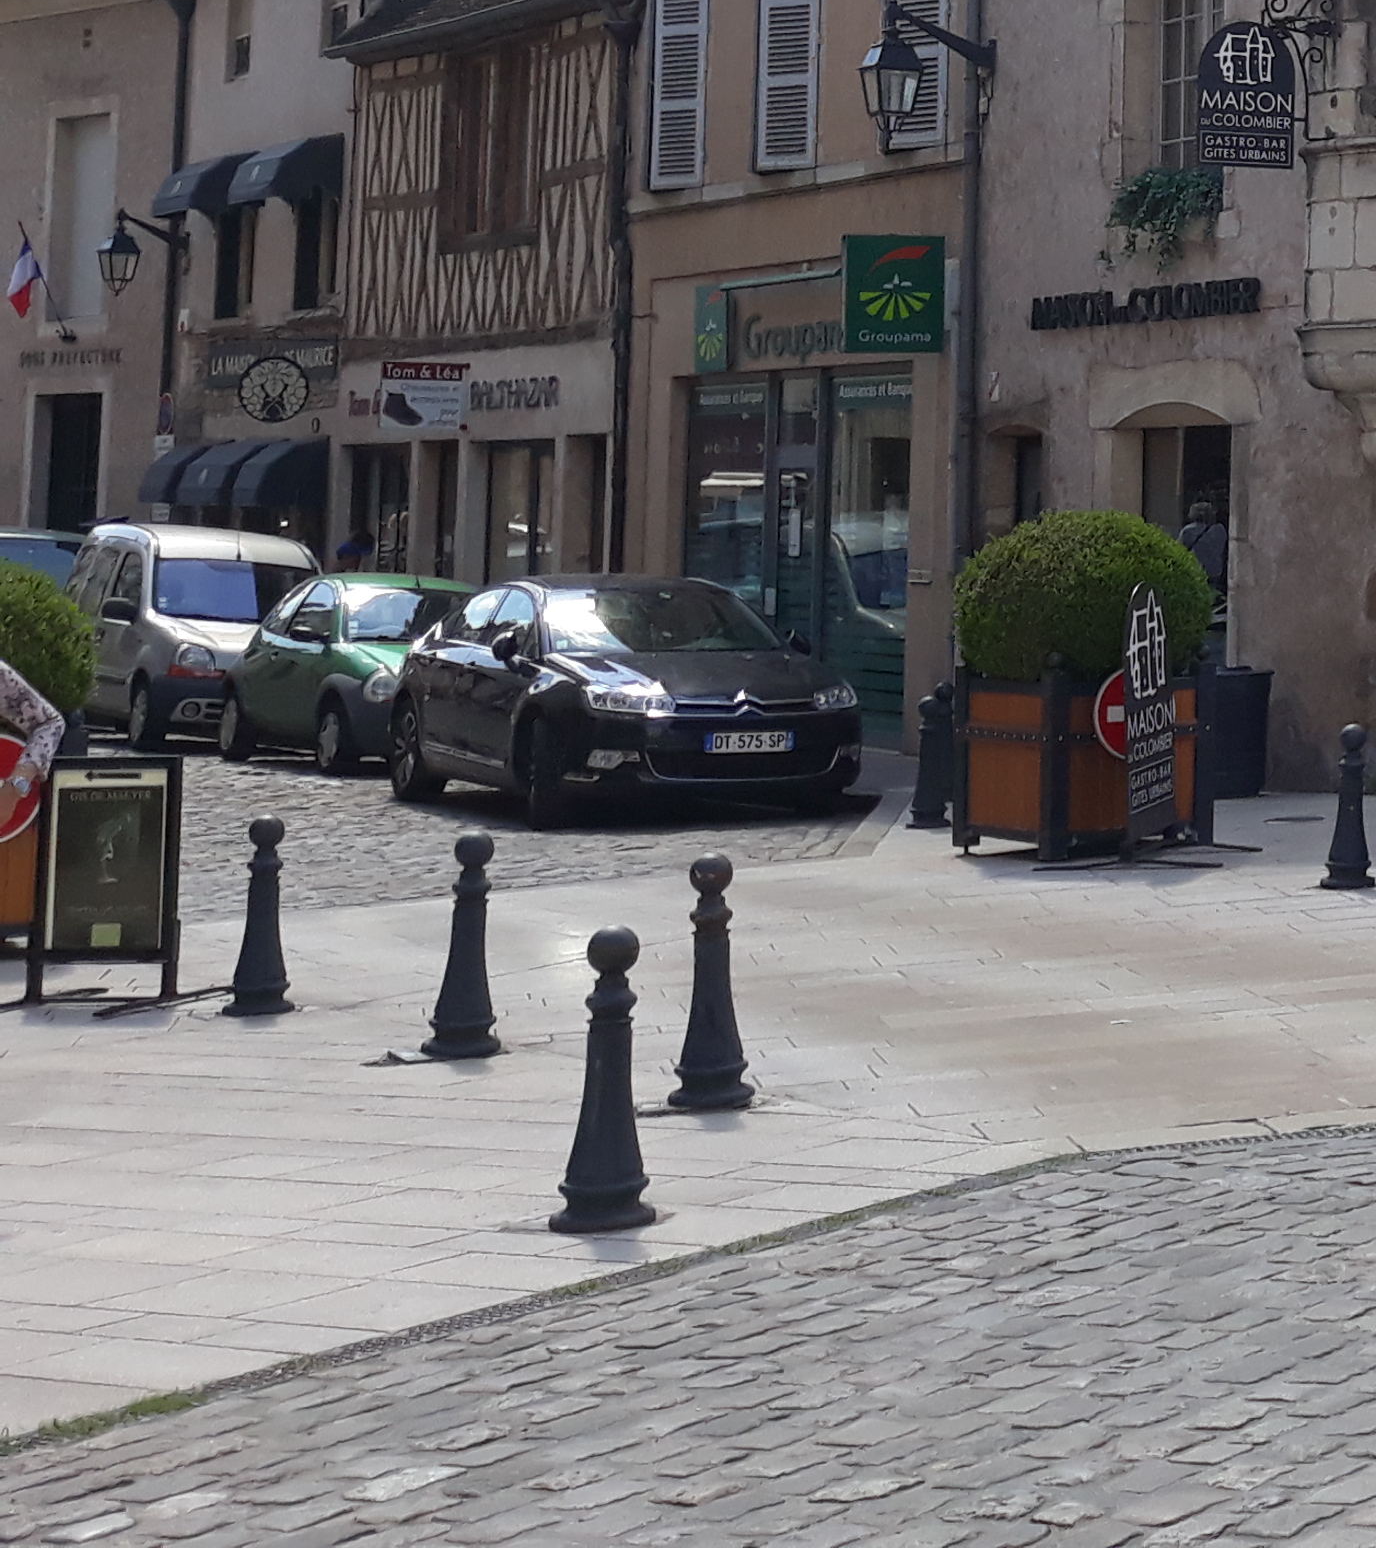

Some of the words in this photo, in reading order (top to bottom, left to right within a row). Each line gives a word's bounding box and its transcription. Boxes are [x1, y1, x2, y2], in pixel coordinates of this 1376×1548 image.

[1201, 90, 1292, 113] MAISON
[1212, 113, 1291, 129] COLOMBIER
[1204, 148, 1236, 159] GITES
[1239, 150, 1286, 161] URBAINS
[1127, 277, 1261, 323] COLOMBIER
[858, 329, 931, 344] Groupama
[386, 363, 415, 379] Tom
[420, 365, 432, 379] &
[470, 376, 560, 410] BALTHAZAR
[1127, 693, 1176, 741] MAISON
[1133, 731, 1174, 761] COLOMBIER
